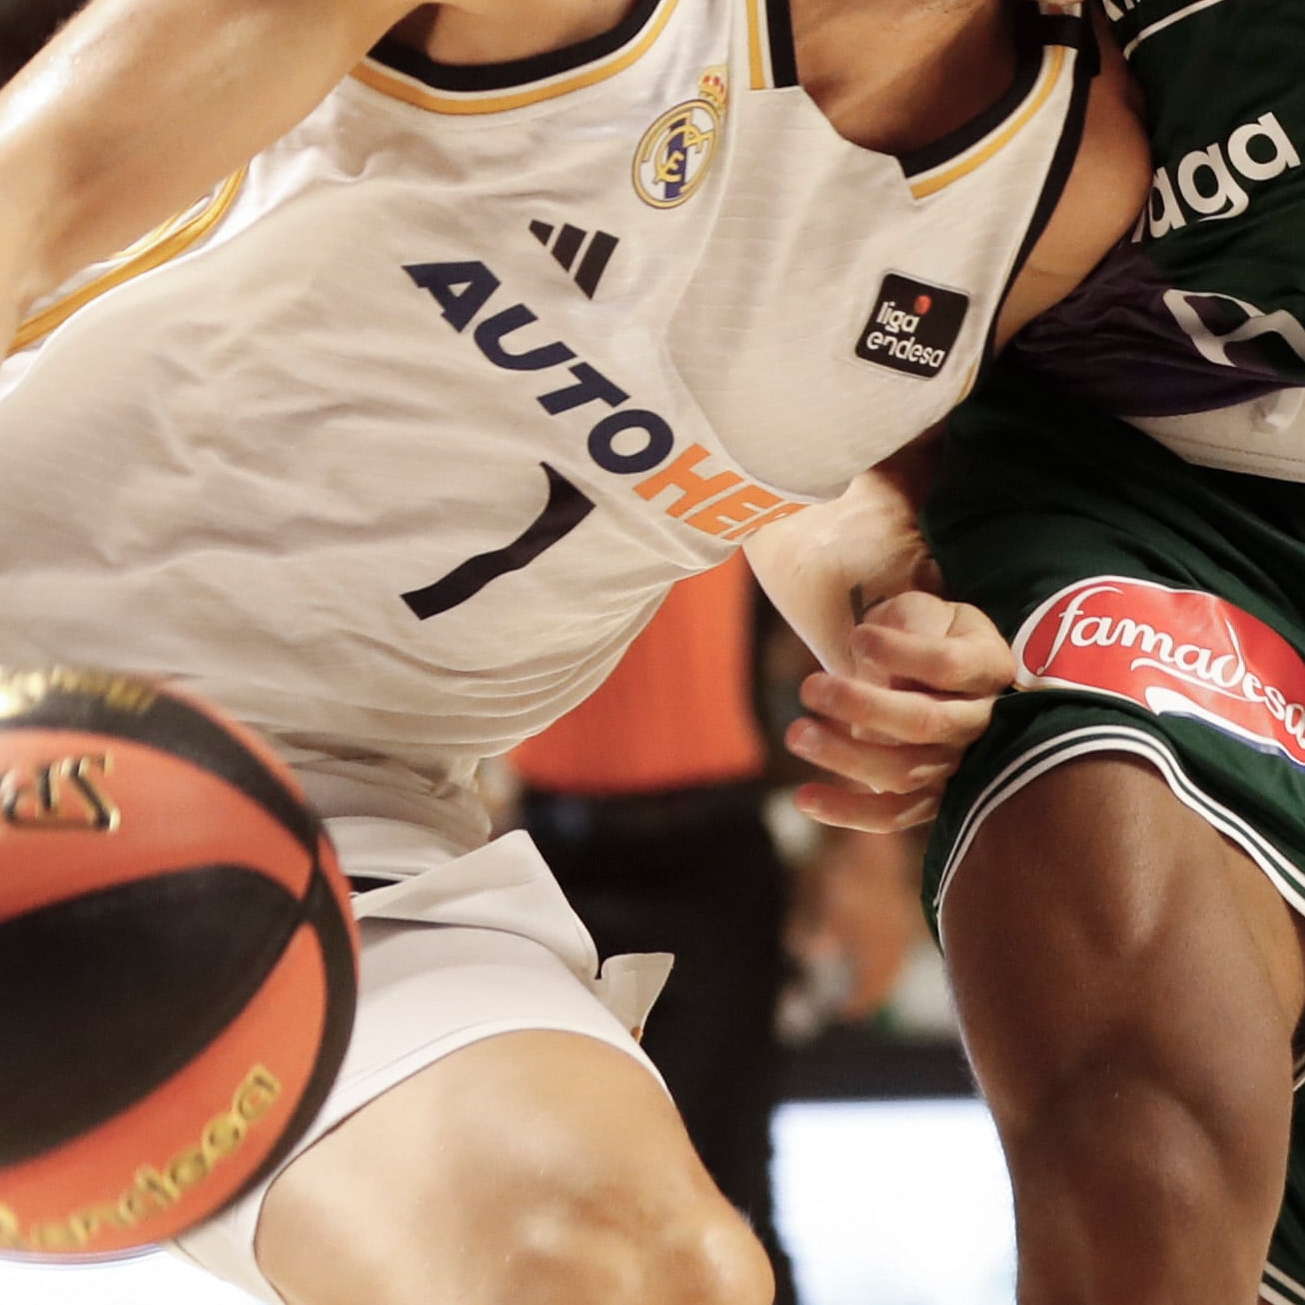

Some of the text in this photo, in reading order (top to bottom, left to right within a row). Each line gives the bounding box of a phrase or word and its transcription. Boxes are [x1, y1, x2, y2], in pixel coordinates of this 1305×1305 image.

[1131, 112, 1301, 243] aga
[876, 301, 920, 333] liga
[866, 331, 946, 367] endesa
